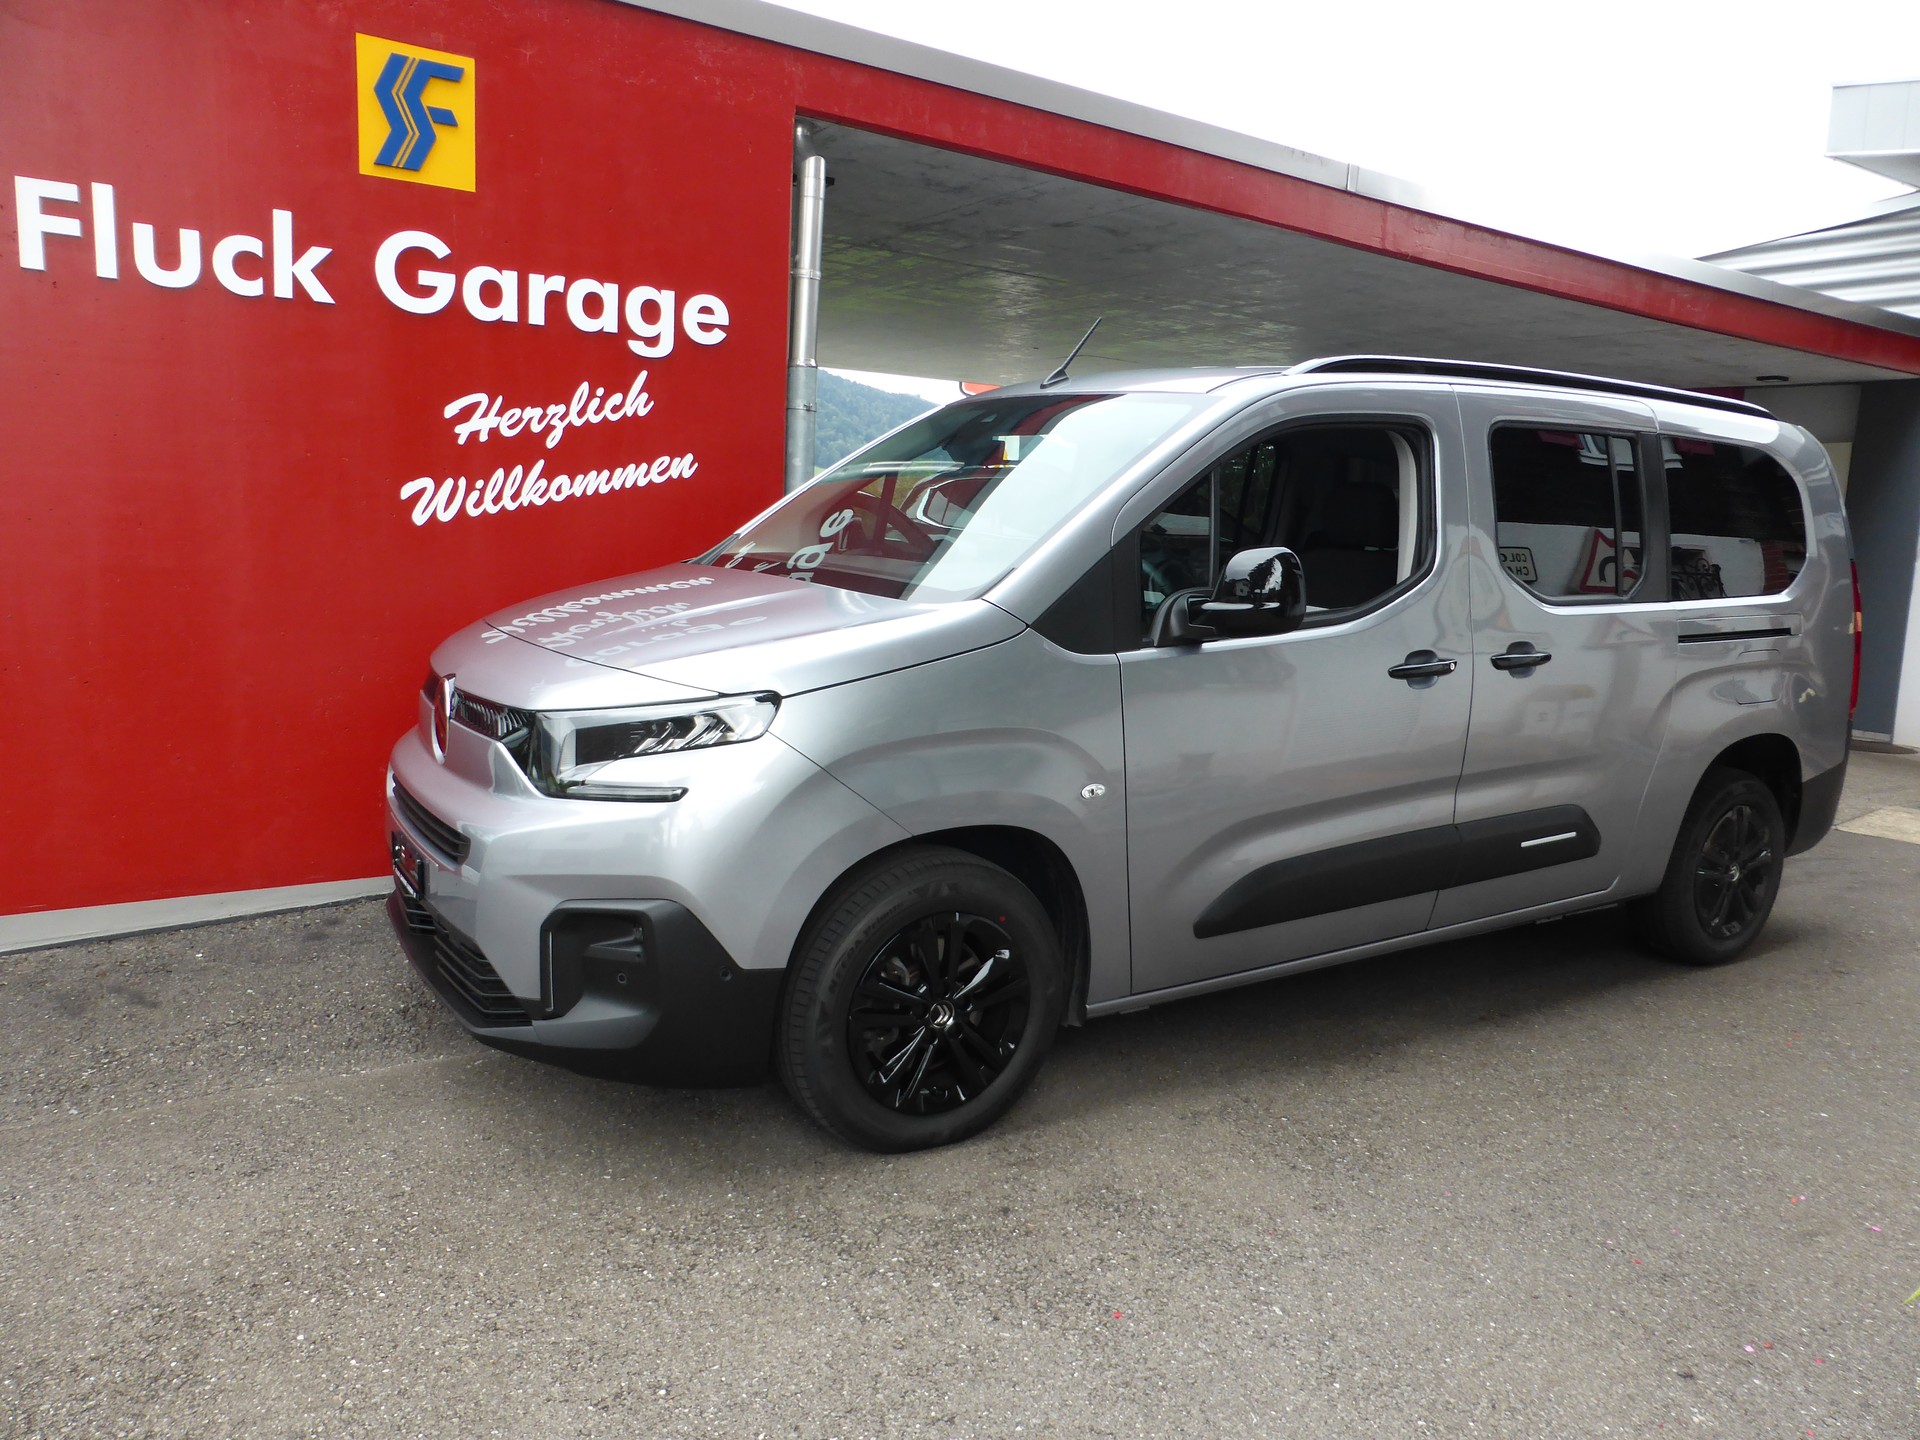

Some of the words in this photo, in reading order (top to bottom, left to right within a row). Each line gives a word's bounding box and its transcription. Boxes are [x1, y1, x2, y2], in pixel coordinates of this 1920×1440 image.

[14, 175, 336, 304] Fluck
[374, 230, 730, 359] Garage
[443, 370, 655, 449] Herzlich
[400, 451, 698, 526] Willkommen
